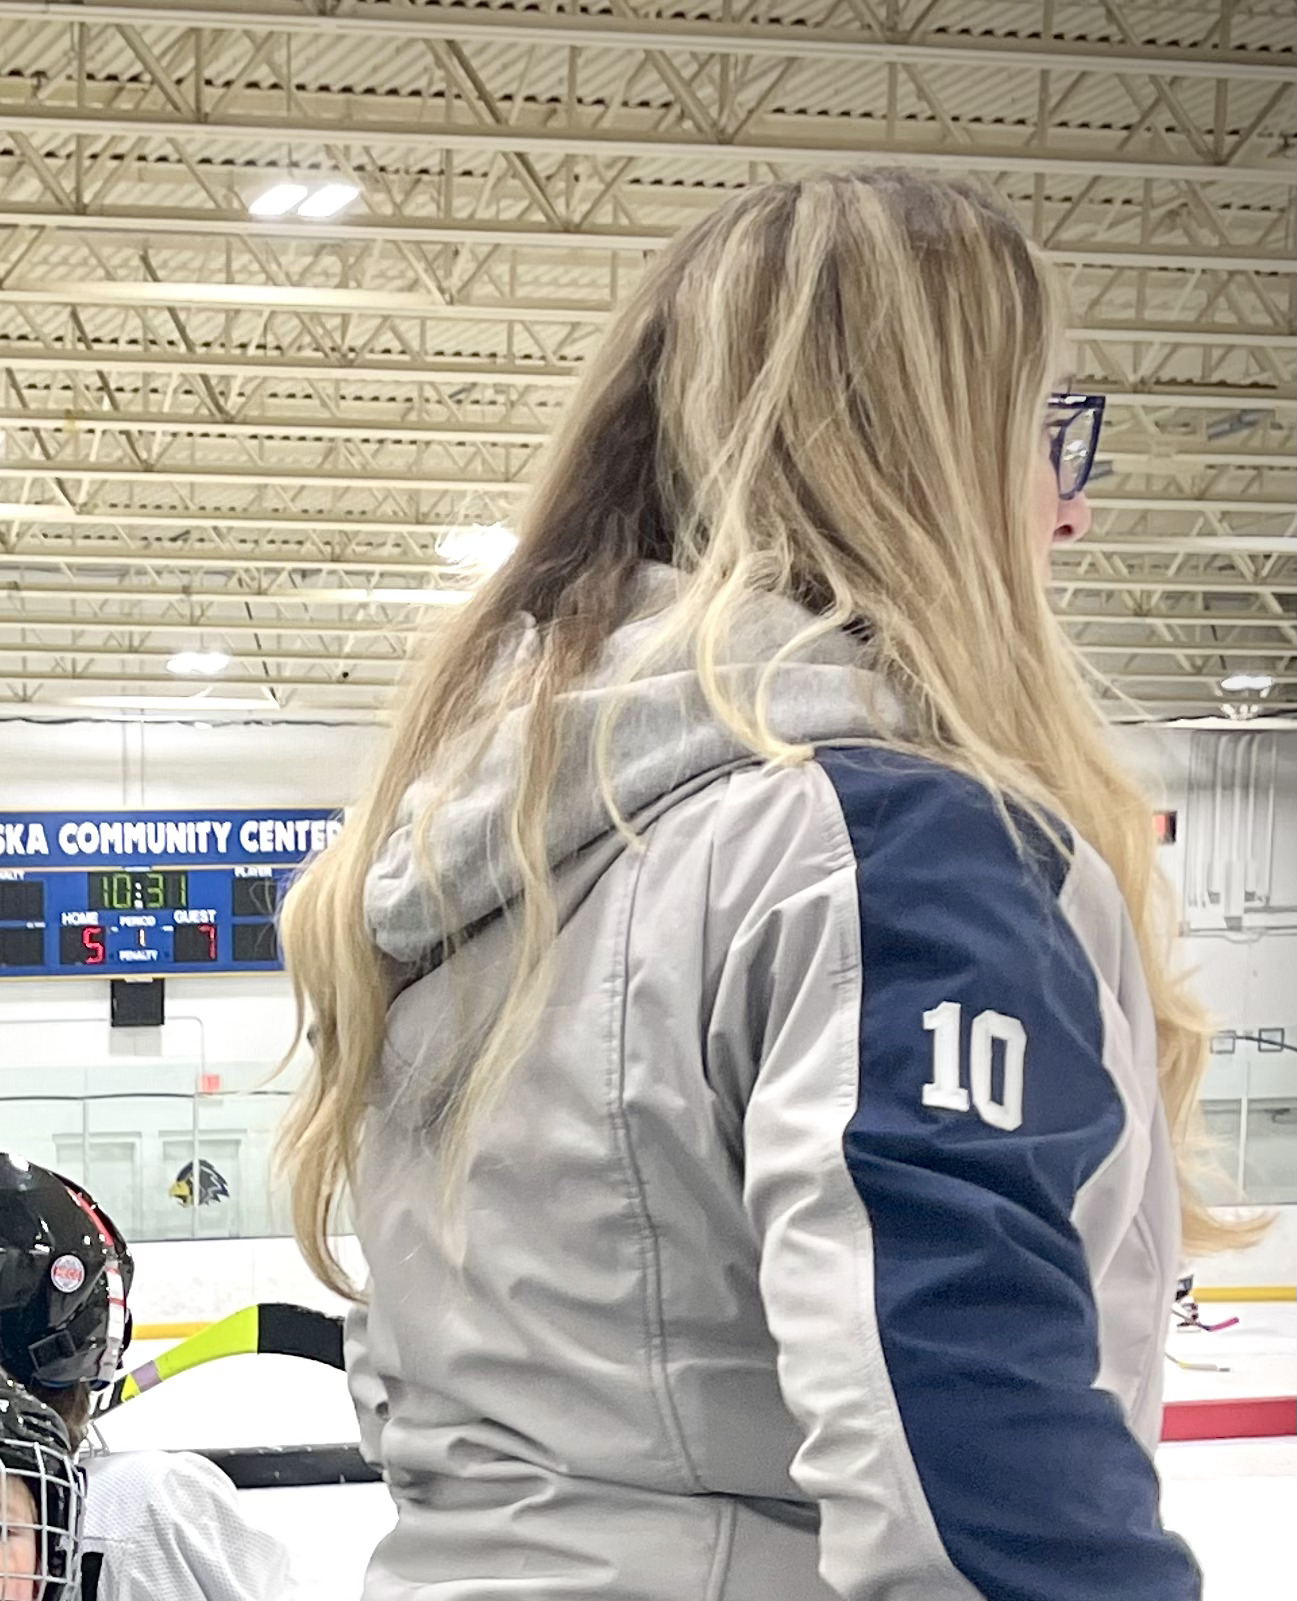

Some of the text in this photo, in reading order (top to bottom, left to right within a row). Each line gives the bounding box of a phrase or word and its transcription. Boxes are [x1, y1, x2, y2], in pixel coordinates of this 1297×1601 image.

[58, 821, 232, 855] COMMUNITY
[101, 872, 188, 909] 10:31
[61, 911, 99, 925] HOME
[174, 910, 217, 924] GUEST
[82, 926, 105, 965] 5
[198, 924, 217, 960] 7
[922, 1001, 1027, 1131] 10
